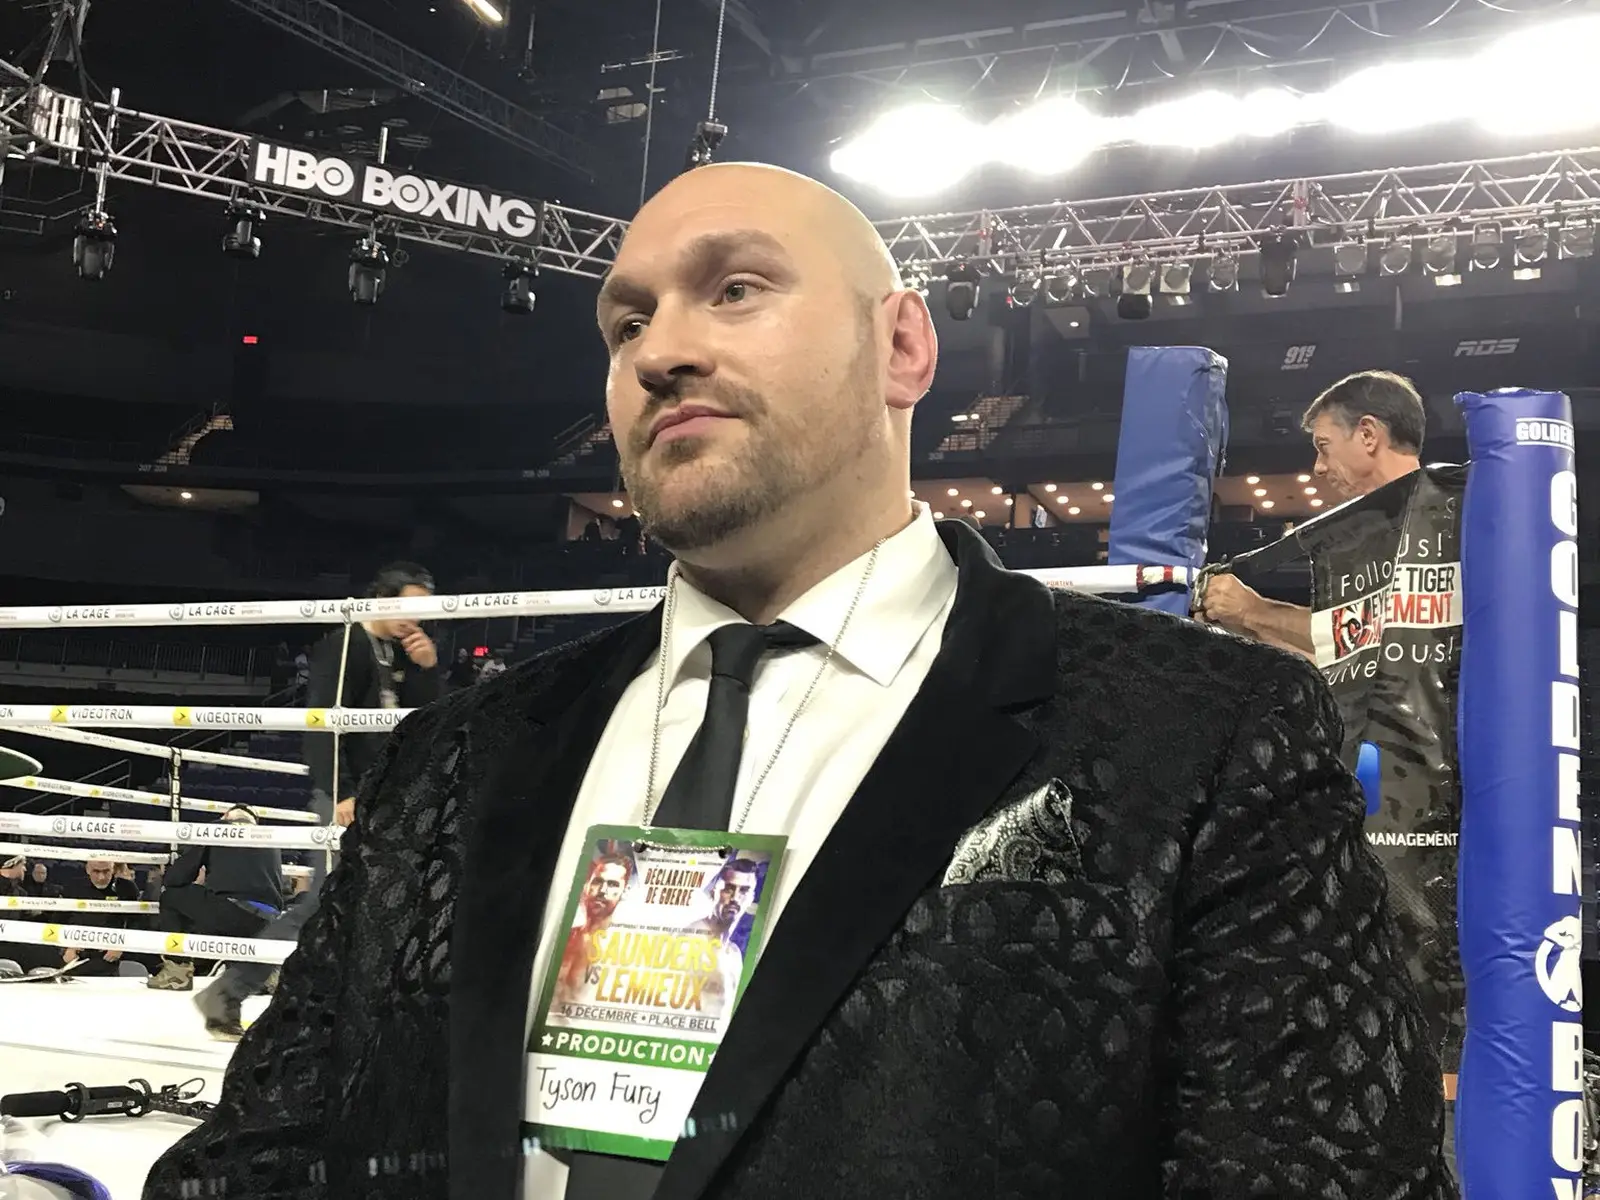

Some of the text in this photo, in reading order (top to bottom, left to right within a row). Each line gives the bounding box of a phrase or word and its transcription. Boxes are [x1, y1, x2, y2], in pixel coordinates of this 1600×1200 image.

[254, 142, 537, 238] HBO BOXING
[1341, 560, 1393, 598] Follo
[1406, 566, 1455, 592] TIGER
[464, 595, 479, 607] LA
[484, 594, 519, 606] CAGE
[618, 587, 667, 600] LA CAG
[66, 608, 78, 619] LA
[82, 608, 111, 619] CAGE
[188, 606, 201, 616] LA
[205, 604, 236, 616] CAGE
[321, 602, 335, 613] LA
[71, 708, 133, 720] VIDEOTRON
[195, 710, 262, 725] VIDEOTRON
[70, 821, 84, 832] LA
[86, 821, 116, 834] CAGE
[196, 827, 210, 837] LA
[213, 827, 246, 838] CAGE
[1366, 832, 1459, 847] MANAGEMENT
[645, 886, 694, 907] DE GUERRE
[63, 929, 126, 945] VIDEOTRON
[188, 939, 256, 956] VIDEOTRON
[587, 929, 722, 973] SAUNDERS
[595, 966, 708, 1012] LEMIEUX
[561, 1004, 573, 1017] 16
[649, 1014, 686, 1028] PLACE
[689, 1018, 717, 1031] BELL
[555, 1031, 705, 1066] PRODUCTION
[536, 1066, 661, 1124] Tyson Fury
